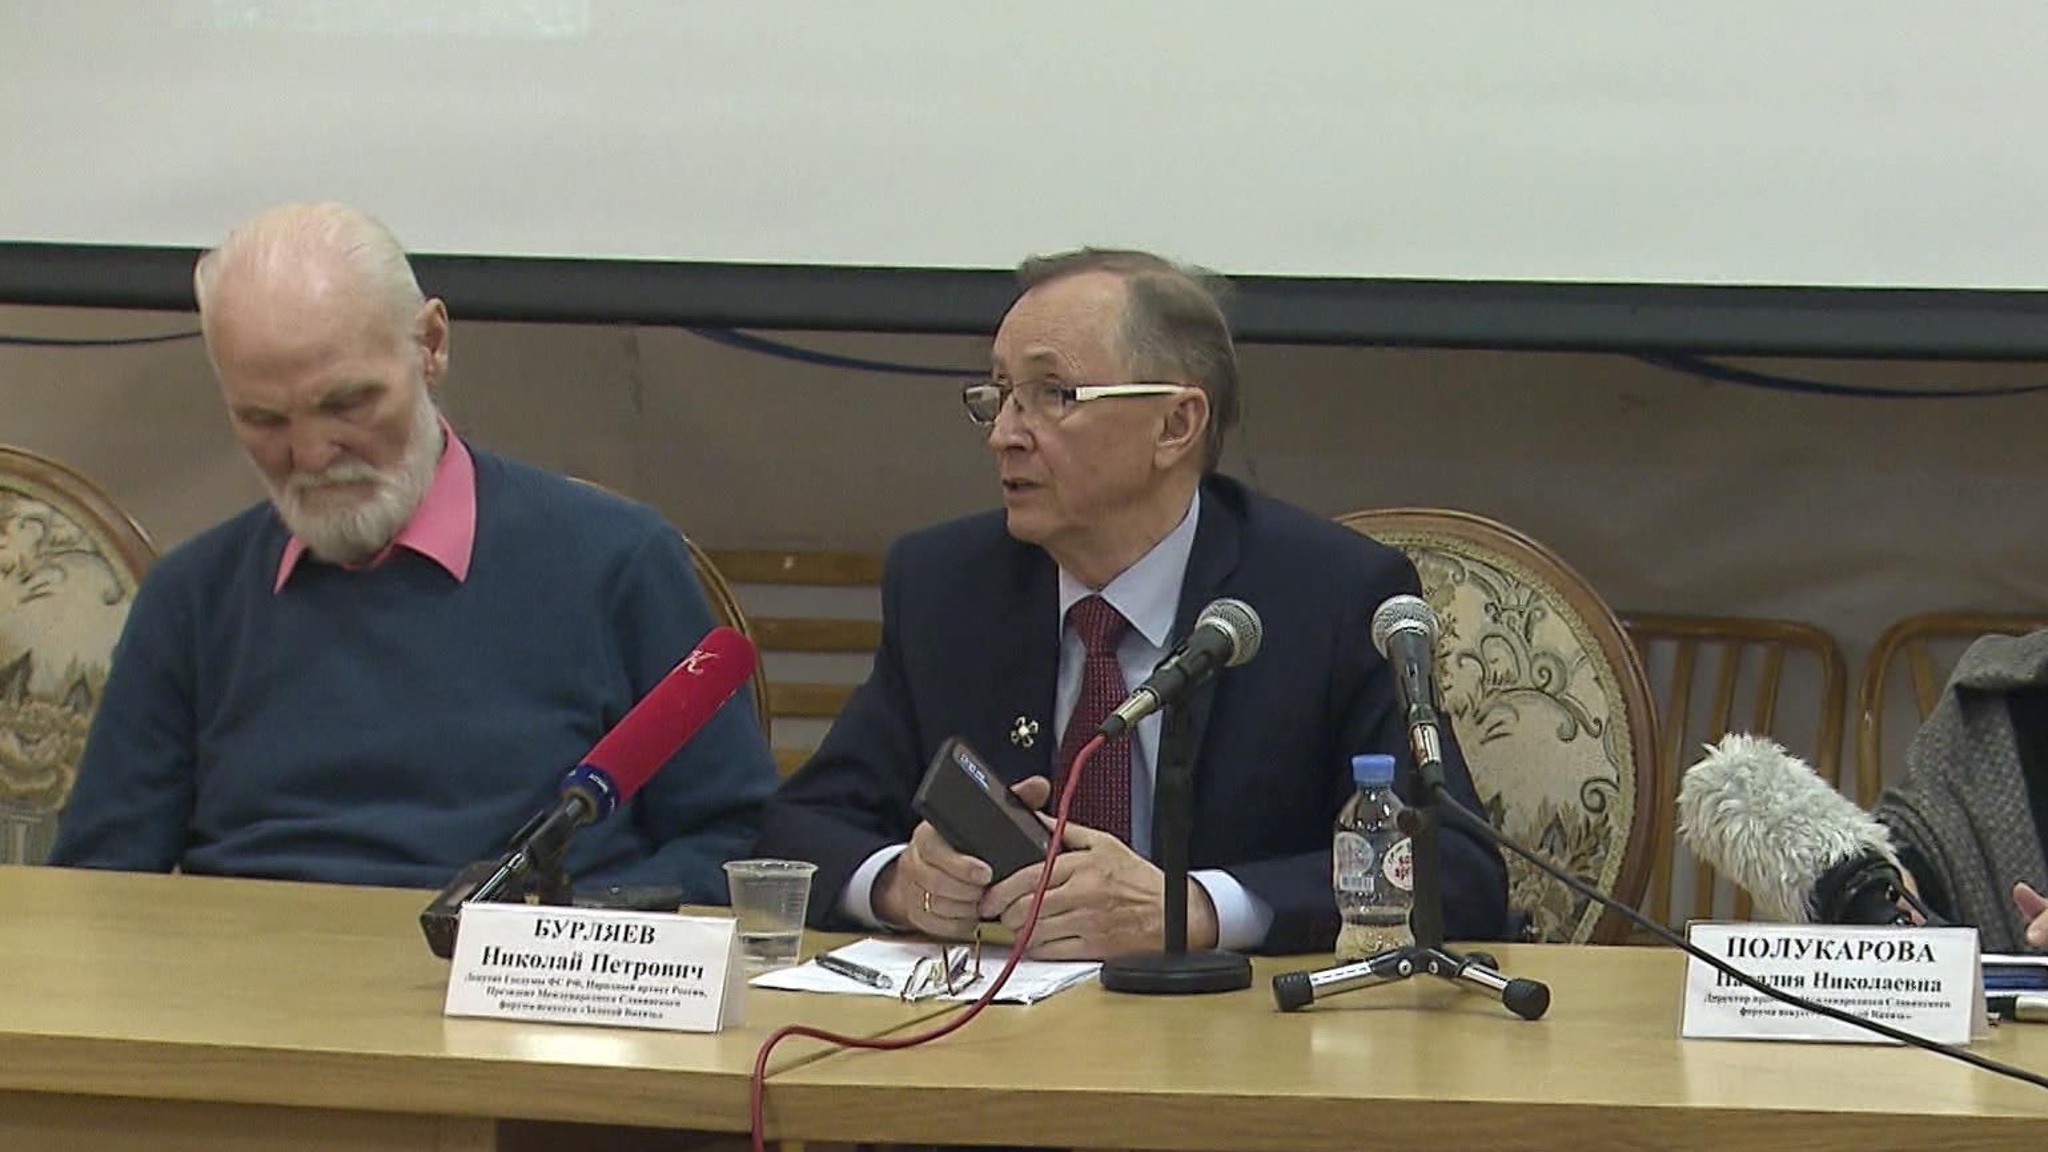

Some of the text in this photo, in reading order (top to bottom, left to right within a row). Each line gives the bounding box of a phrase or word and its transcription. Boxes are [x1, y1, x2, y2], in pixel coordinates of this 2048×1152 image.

[534, 918, 656, 945] БУРЛЯЕВ
[1726, 935, 1936, 963] ПОЛУКАРОВА
[481, 946, 704, 981] Николай Петрович
[1813, 970, 1942, 994] Николаевна
